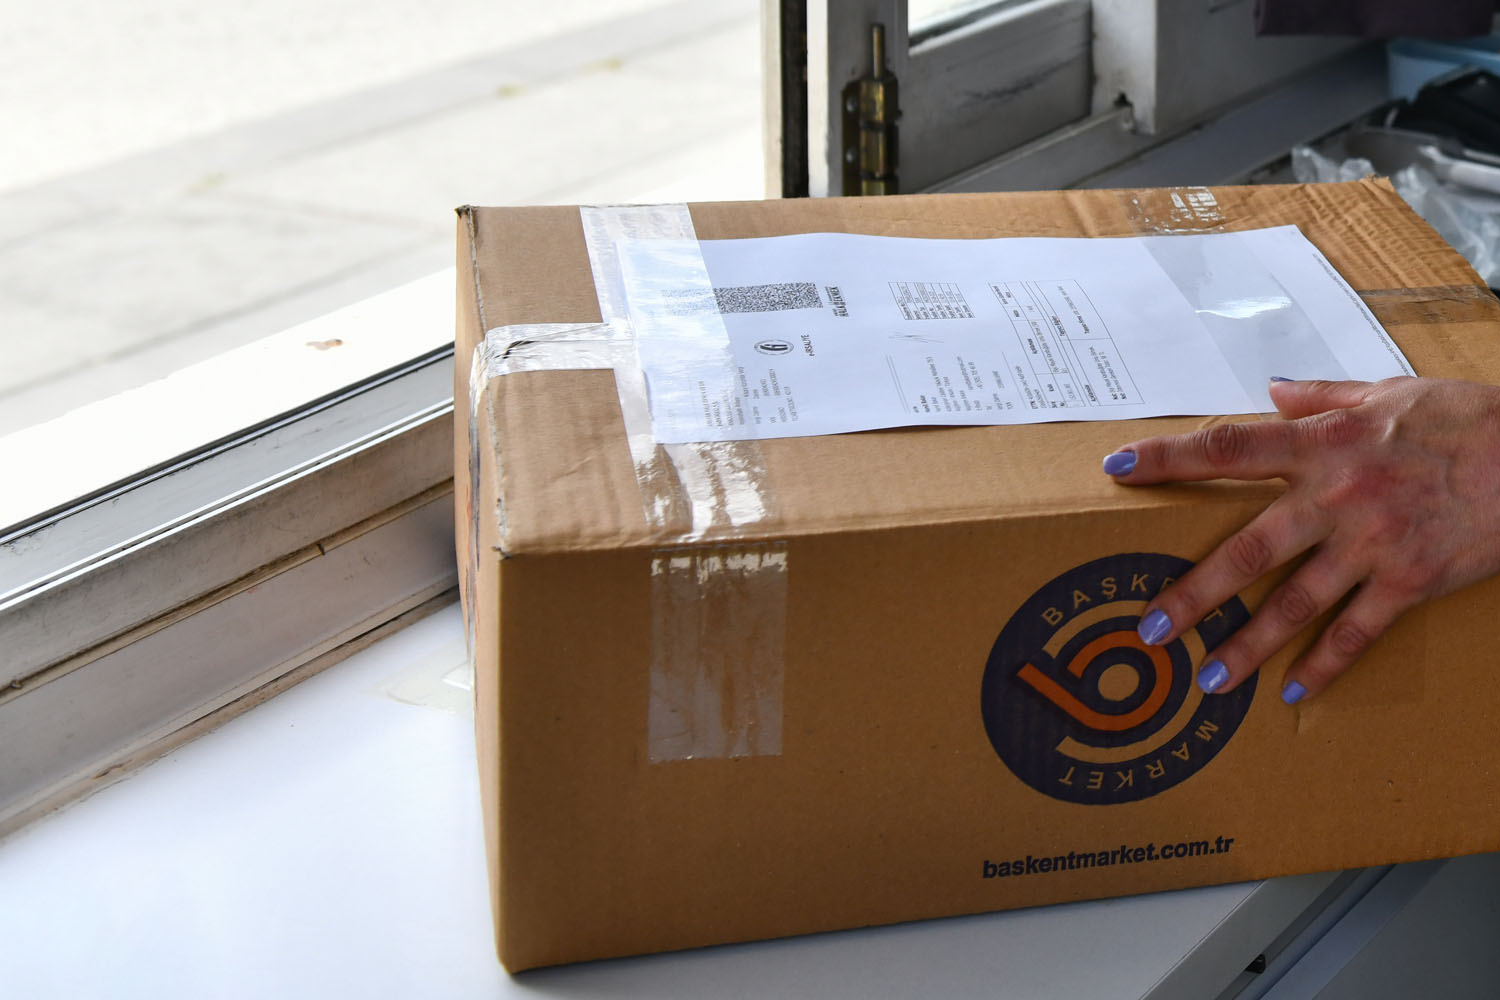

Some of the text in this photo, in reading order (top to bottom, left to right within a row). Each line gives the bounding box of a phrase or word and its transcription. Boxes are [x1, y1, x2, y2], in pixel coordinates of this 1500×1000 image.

[1041, 573, 1223, 626] BAŞKT
[1058, 719, 1219, 793] MARKET
[982, 835, 1234, 878] baskentmarket.com.tr
